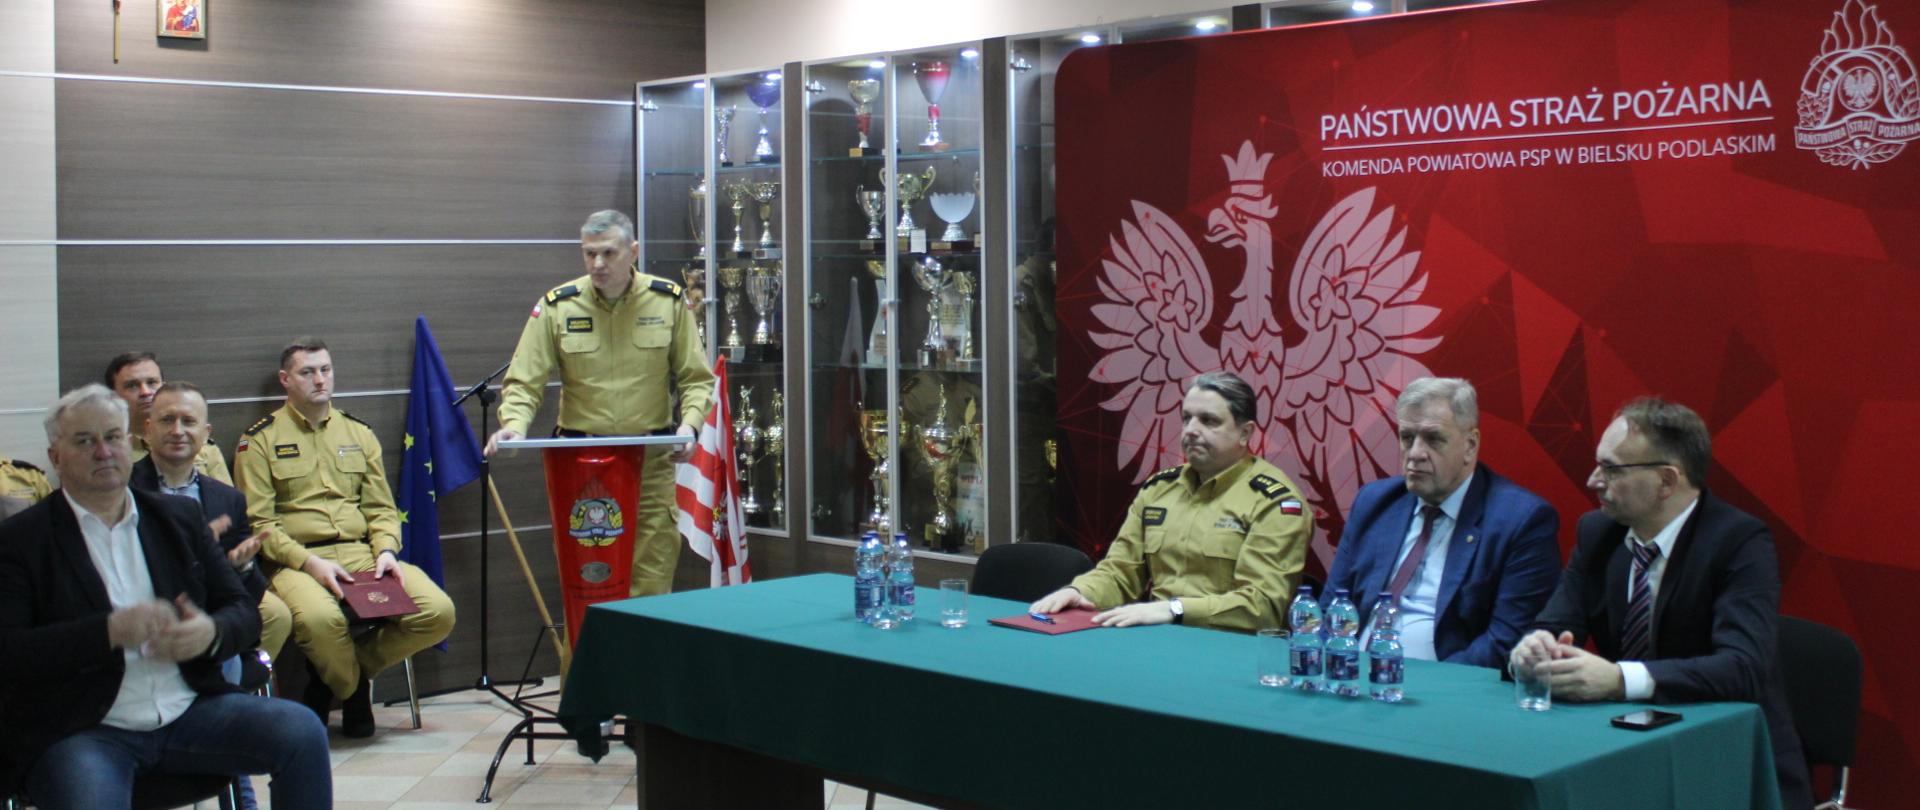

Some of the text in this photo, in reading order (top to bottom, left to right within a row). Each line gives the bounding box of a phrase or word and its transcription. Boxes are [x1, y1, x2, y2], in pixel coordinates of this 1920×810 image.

[1320, 79, 1772, 141] PAŃSTWOWA STRAŻ POŻARNA
[1322, 133, 1776, 178] KOMENDA POWIATOWA PSP W BIELSKU PODLASKIM
